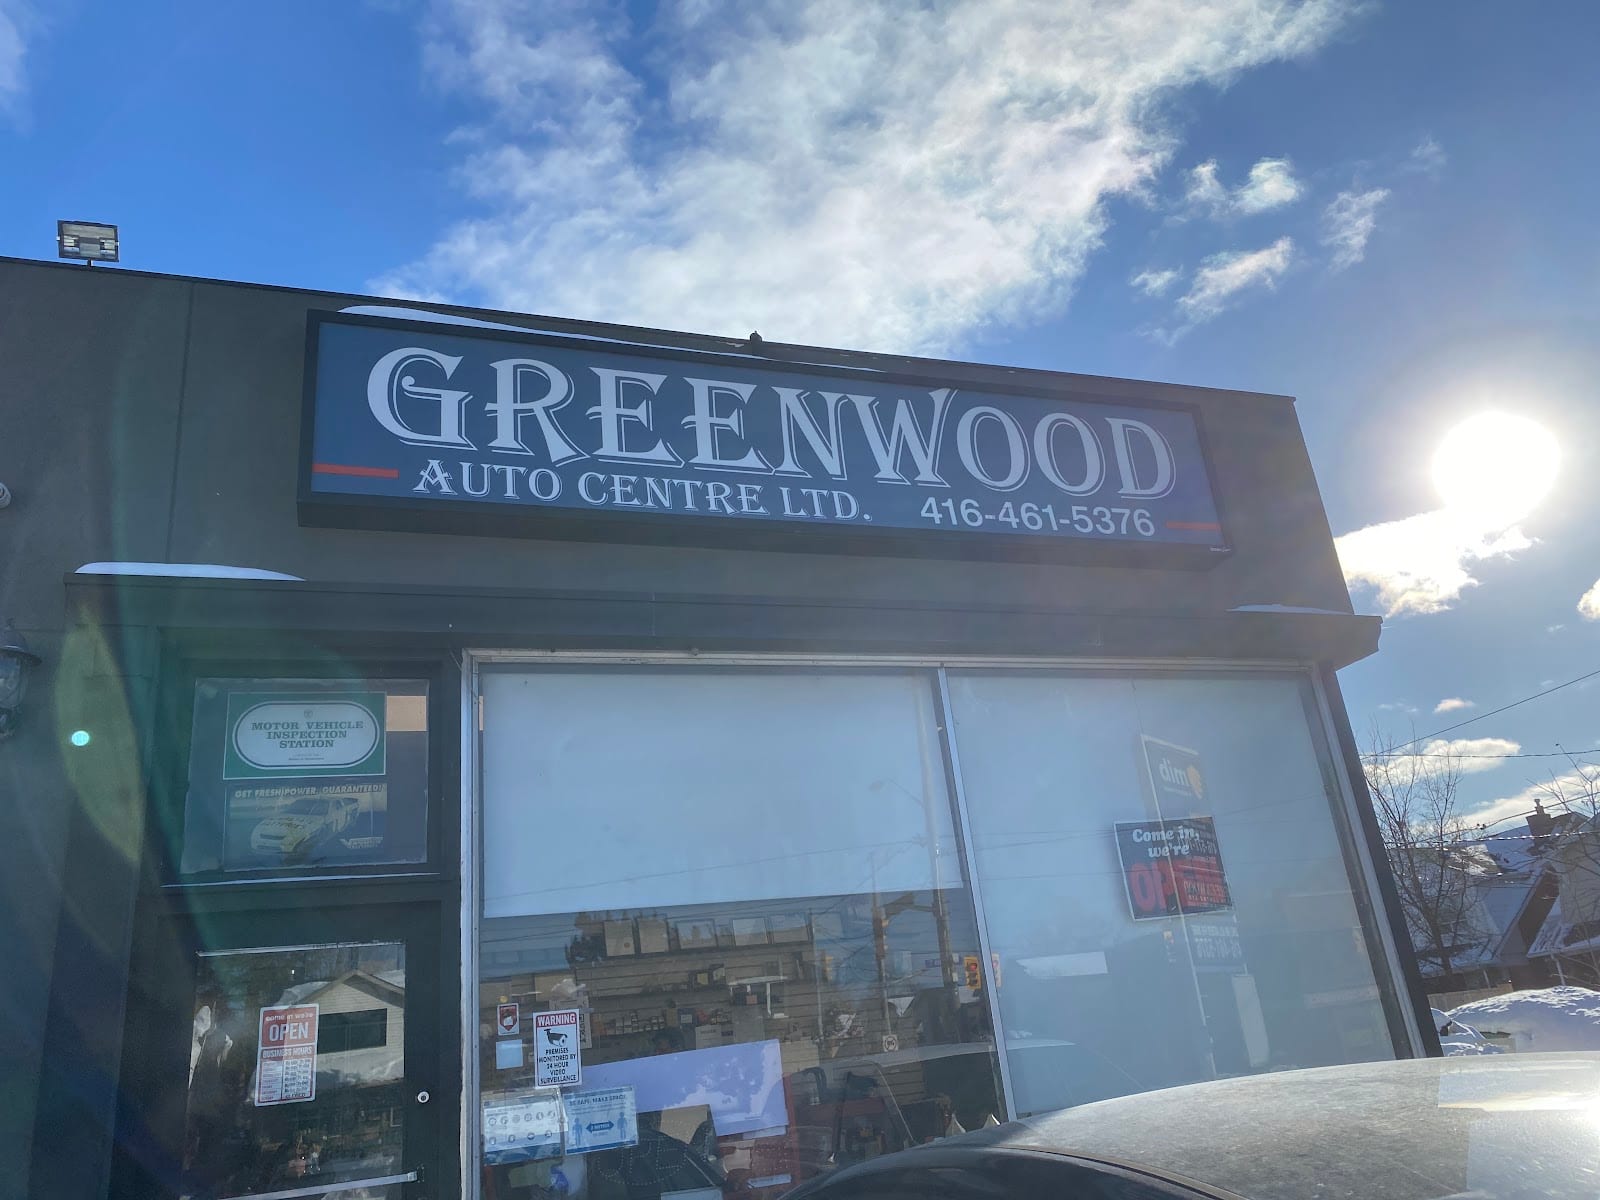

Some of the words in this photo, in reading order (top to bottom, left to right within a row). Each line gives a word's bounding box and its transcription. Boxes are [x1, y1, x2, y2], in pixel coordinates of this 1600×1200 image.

[367, 347, 1177, 500] GREENWOOD
[413, 459, 562, 502] AUTO
[578, 472, 771, 517] CENTRE
[779, 486, 873, 522] LTD.
[920, 497, 1156, 537] 416-461-5376
[251, 722, 299, 731] MOTOR
[306, 720, 364, 730] VEHICLE
[266, 730, 347, 740] INSPECTION
[279, 739, 334, 749] STATION
[235, 789, 252, 798] GET
[1133, 828, 1174, 842] Come
[1178, 826, 1200, 841] in,
[1148, 843, 1190, 858] we're
[537, 1013, 576, 1027] WARNING
[269, 1022, 309, 1042] OPEN
[263, 1048, 292, 1059] BUSINESS
[293, 1046, 312, 1056] HOURS
[545, 1047, 569, 1055] PREMISES
[539, 1055, 569, 1064] MONITORED
[570, 1053, 577, 1061] BY
[554, 1061, 569, 1069] HOUR
[540, 1075, 577, 1085] SURVEILLANCE
